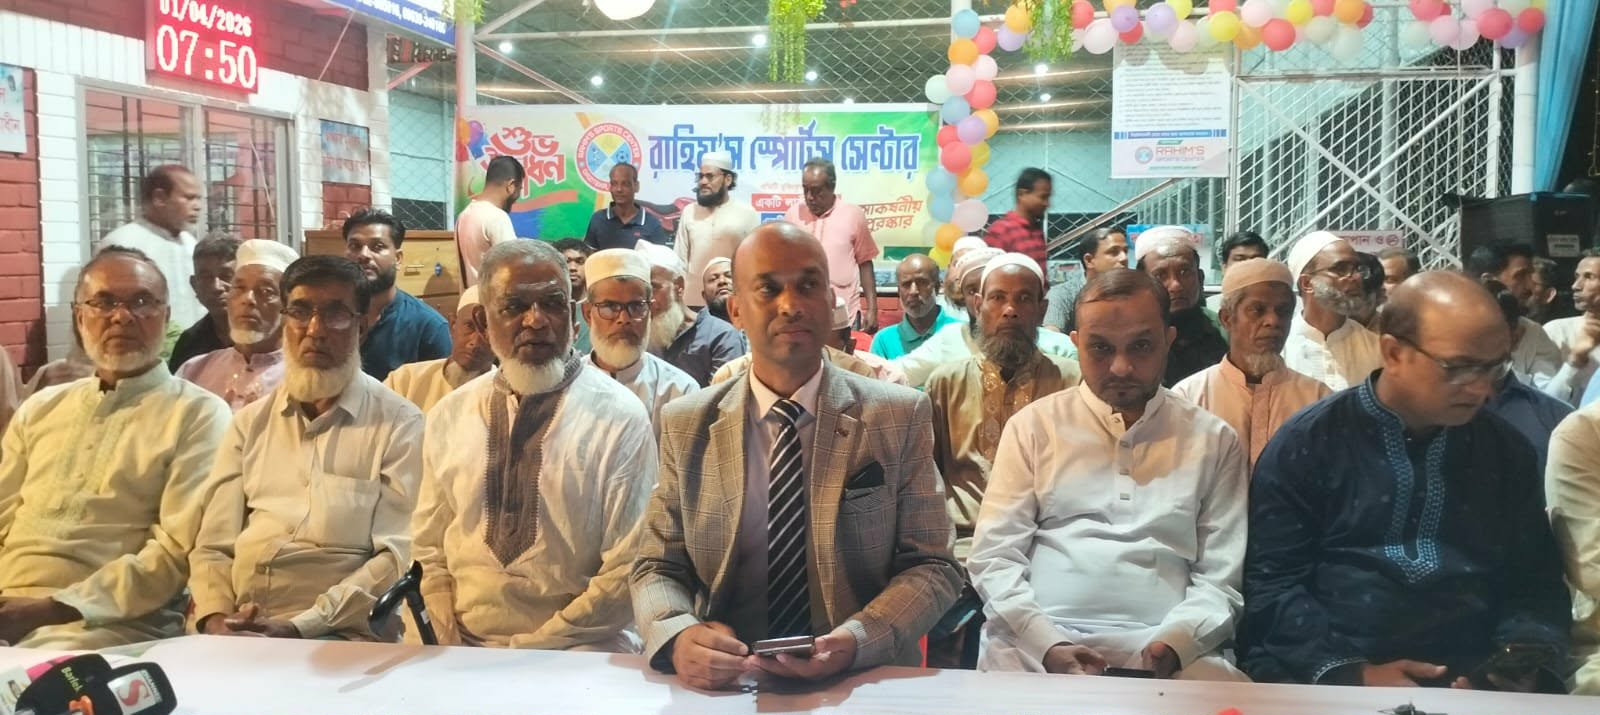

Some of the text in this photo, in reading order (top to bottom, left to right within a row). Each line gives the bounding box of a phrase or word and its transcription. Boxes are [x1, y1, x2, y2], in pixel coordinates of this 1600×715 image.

[159, 0, 253, 37] 01/04/2026
[156, 25, 257, 89] 07:50
[490, 126, 560, 157] শুভ
[841, 126, 920, 179] সেন্টার
[1155, 146, 1205, 156] RAHIM'S
[755, 195, 782, 208] একটি
[117, 678, 152, 706] S
